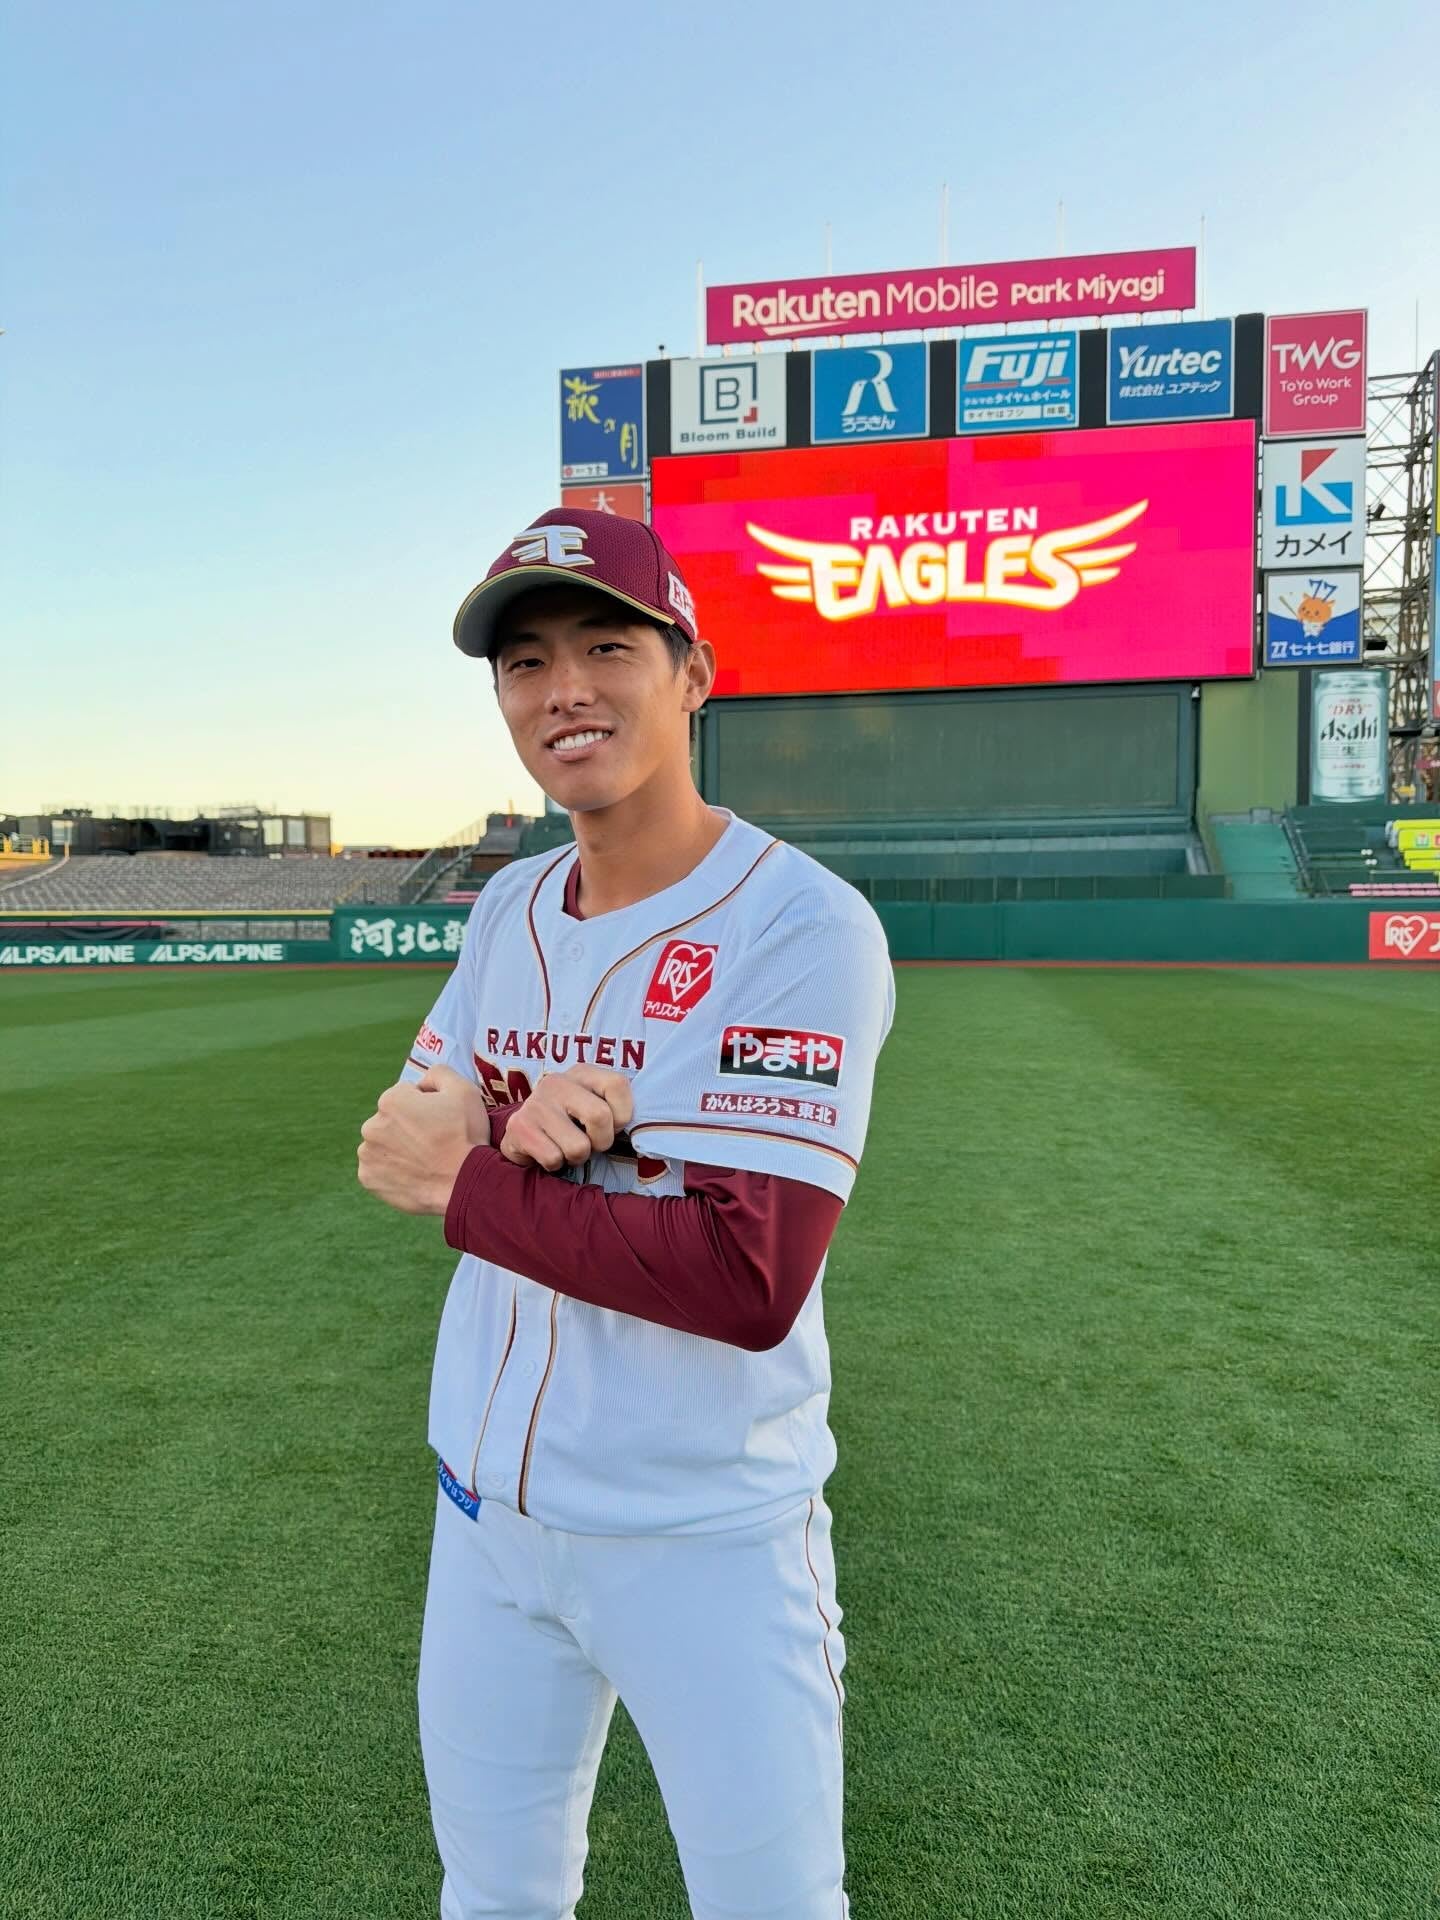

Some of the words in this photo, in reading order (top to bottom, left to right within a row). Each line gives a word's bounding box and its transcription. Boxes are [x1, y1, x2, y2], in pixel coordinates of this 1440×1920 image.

[732, 286, 881, 328] Rakuten
[886, 274, 999, 316] Mobile
[1011, 277, 1072, 306] Park
[1077, 268, 1165, 305] Miyagi
[965, 340, 1071, 388] Fuji
[1119, 345, 1222, 379] Yurtec
[1271, 336, 1361, 373] TWG
[1166, 380, 1222, 395] ユアテック
[1316, 376, 1352, 389] Work
[1293, 394, 1338, 406] Group
[680, 432, 730, 443] Bloom
[736, 427, 777, 440] Build
[841, 415, 896, 433] ろうきん
[850, 506, 1039, 541] RAKUTEN
[1275, 531, 1352, 557] カメイ
[808, 533, 1083, 623] EAGLES
[1289, 640, 1355, 657] 七十七銀行
[1320, 716, 1378, 741] Asahi
[658, 957, 699, 988] IRIS
[487, 1027, 647, 1071] RAKUTEN
[727, 1031, 838, 1076] やまや
[705, 1094, 781, 1114] がんばろう
[797, 1102, 832, 1124] 東北
